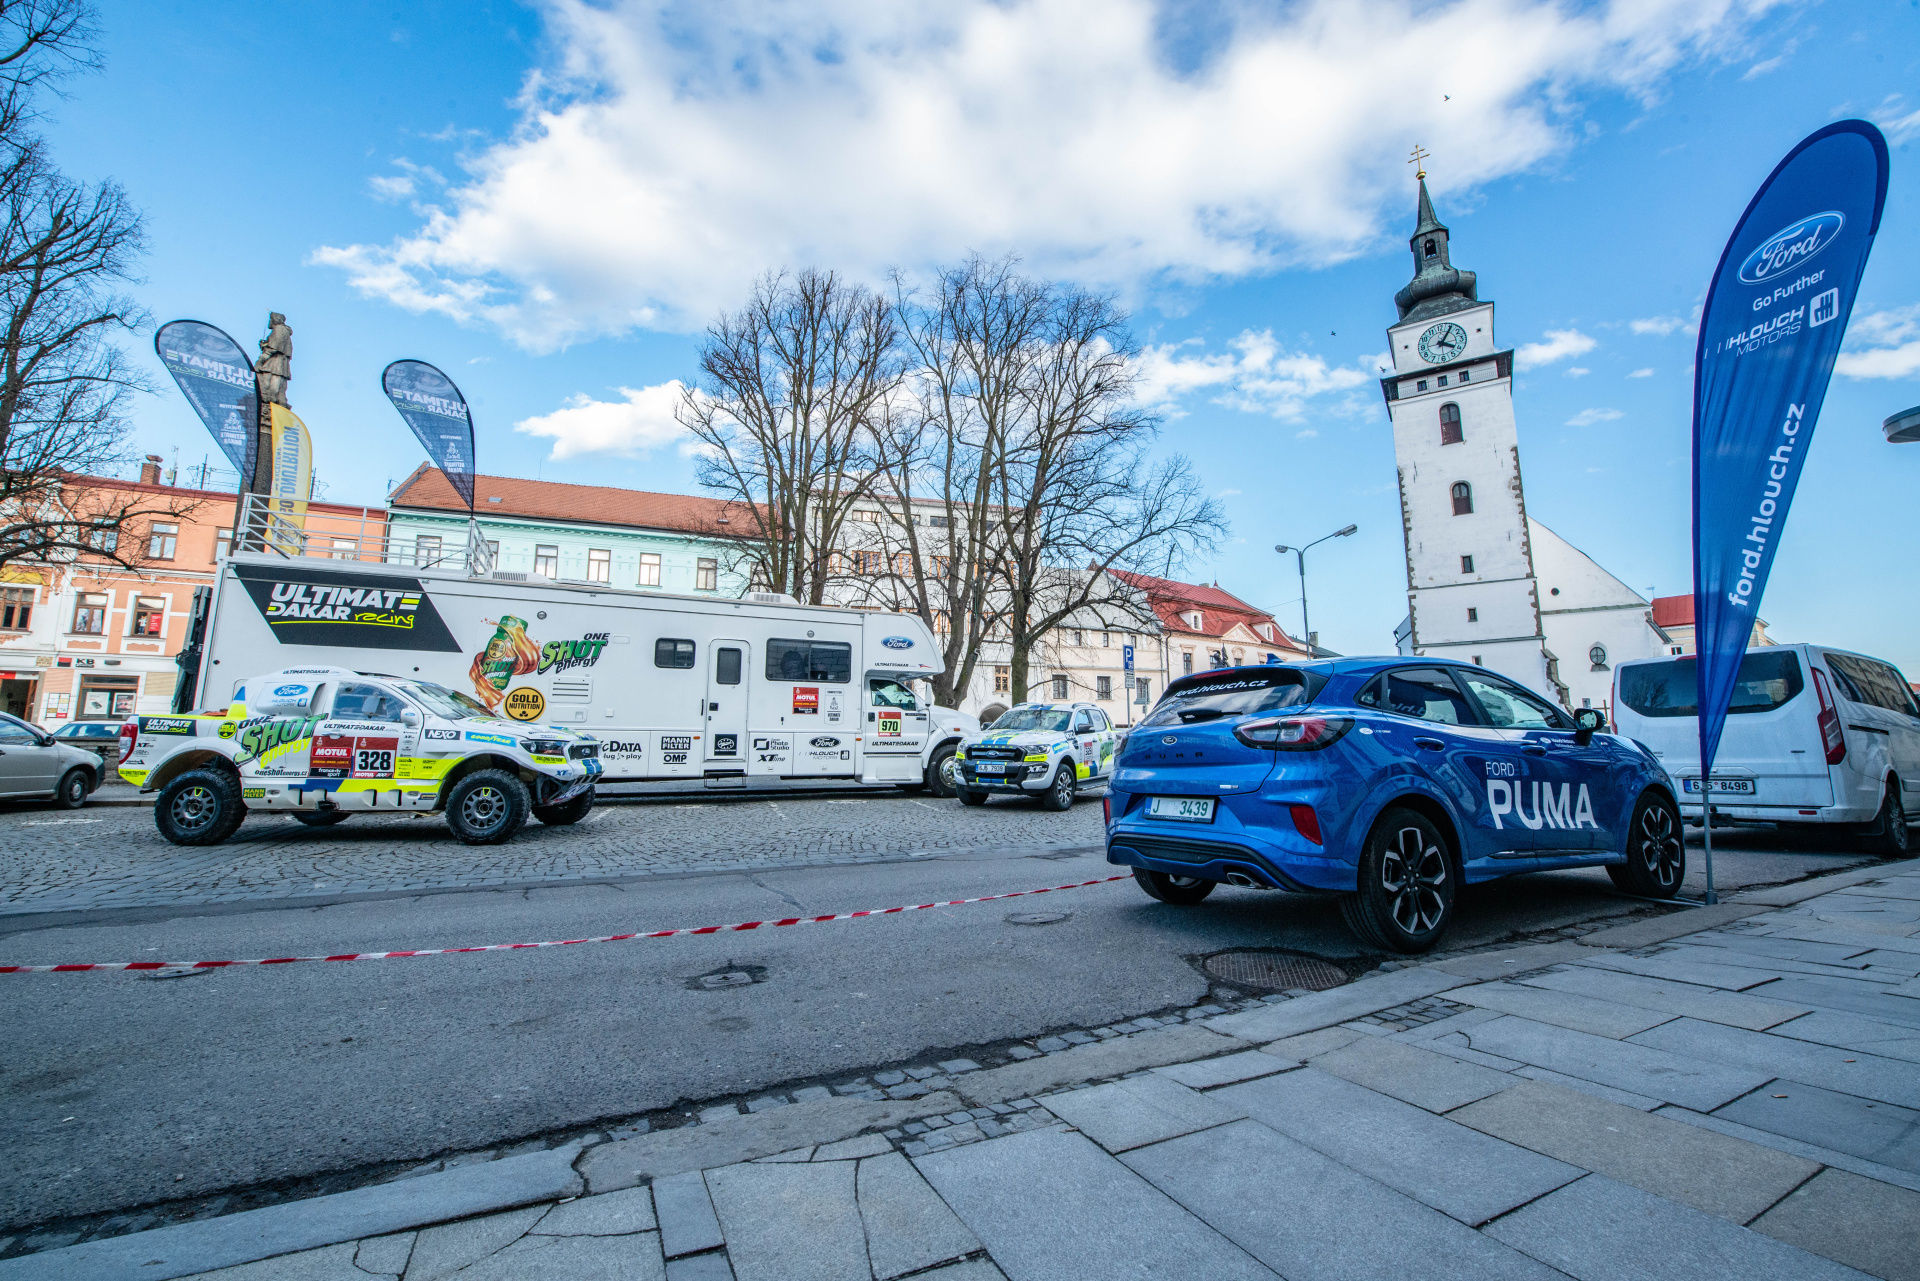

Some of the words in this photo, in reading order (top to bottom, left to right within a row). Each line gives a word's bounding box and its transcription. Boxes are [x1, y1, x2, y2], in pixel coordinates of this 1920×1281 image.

[1755, 224, 1822, 278] Ford
[1753, 295, 1772, 312] Go
[1773, 269, 1825, 302] Further
[1728, 304, 1805, 349] HLOUCH
[1736, 321, 1801, 357] MOTORS
[1728, 402, 1806, 607] ford.hlouch.cz
[270, 583, 422, 611] ULTIMATE
[266, 601, 351, 621] DAKAR
[354, 609, 415, 630] racing
[583, 632, 611, 641] ONE
[886, 638, 909, 649] Ford
[537, 639, 609, 676] SHOT
[1125, 647, 1132, 663] P
[555, 656, 599, 675] energy
[277, 685, 302, 695] Ford
[508, 702, 541, 710] NUTRITION
[511, 693, 539, 704] GOLD
[148, 718, 192, 727] ULTIMATE
[238, 713, 277, 729] ONE
[881, 720, 899, 731] 970
[234, 713, 329, 768] SHOT
[427, 729, 457, 740] NEXO
[663, 736, 691, 744] MANN
[260, 737, 312, 769] energy
[315, 747, 348, 757] MOTUL
[625, 753, 642, 761] play
[663, 753, 688, 763] OMP
[358, 750, 392, 771] 328
[1485, 761, 1515, 777] FORD
[1692, 781, 1713, 791] 65
[1720, 781, 1748, 791] 8498
[1152, 799, 1161, 814] J
[1179, 800, 1209, 817] 3439
[1486, 779, 1599, 831] PUMA
